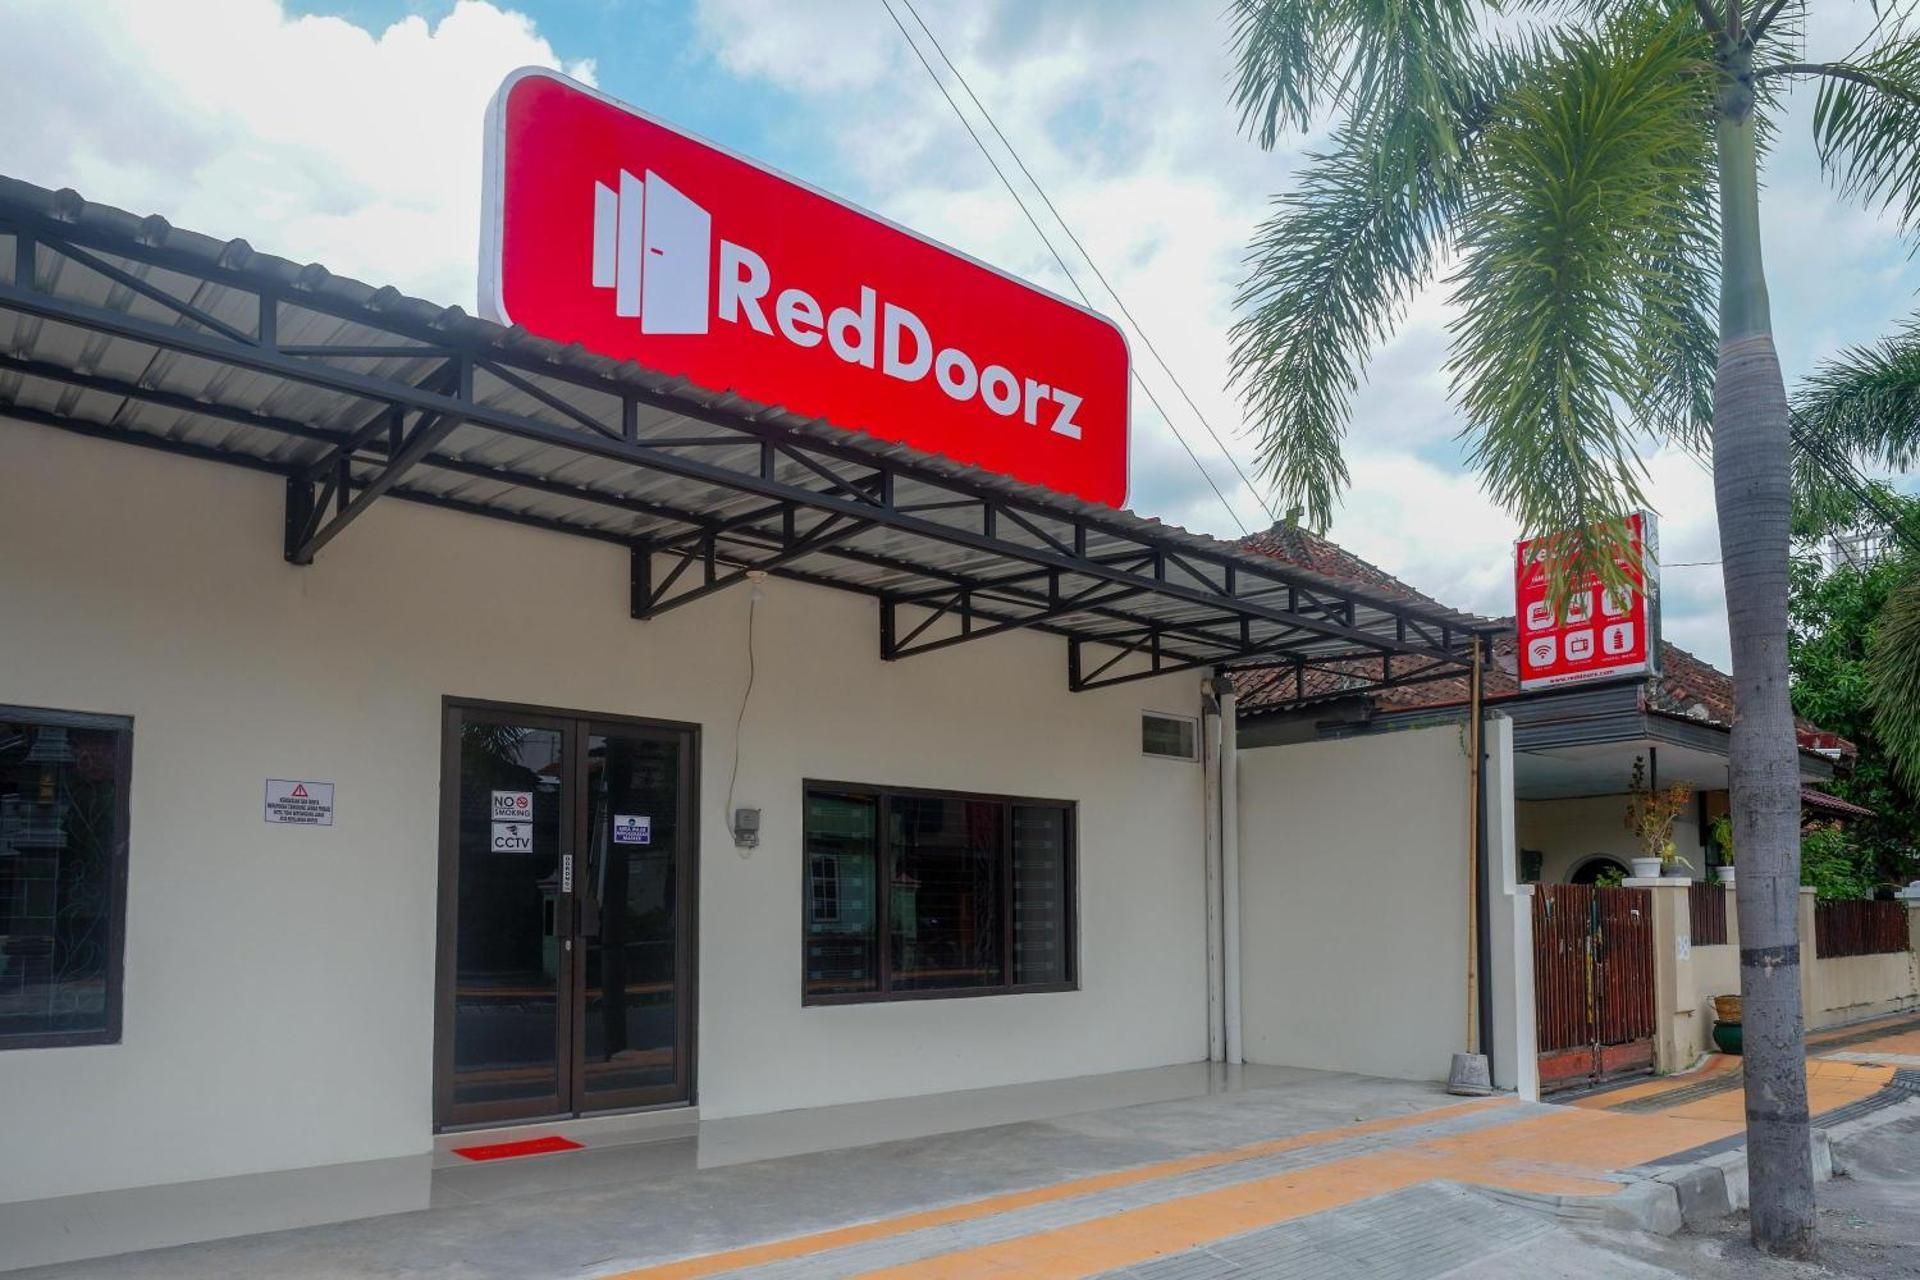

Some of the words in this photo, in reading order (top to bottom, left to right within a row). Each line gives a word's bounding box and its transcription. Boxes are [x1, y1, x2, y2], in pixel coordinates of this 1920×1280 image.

[718, 239, 1084, 440] RedDoorz
[495, 796, 514, 807] NO
[495, 836, 530, 848] CCTV
